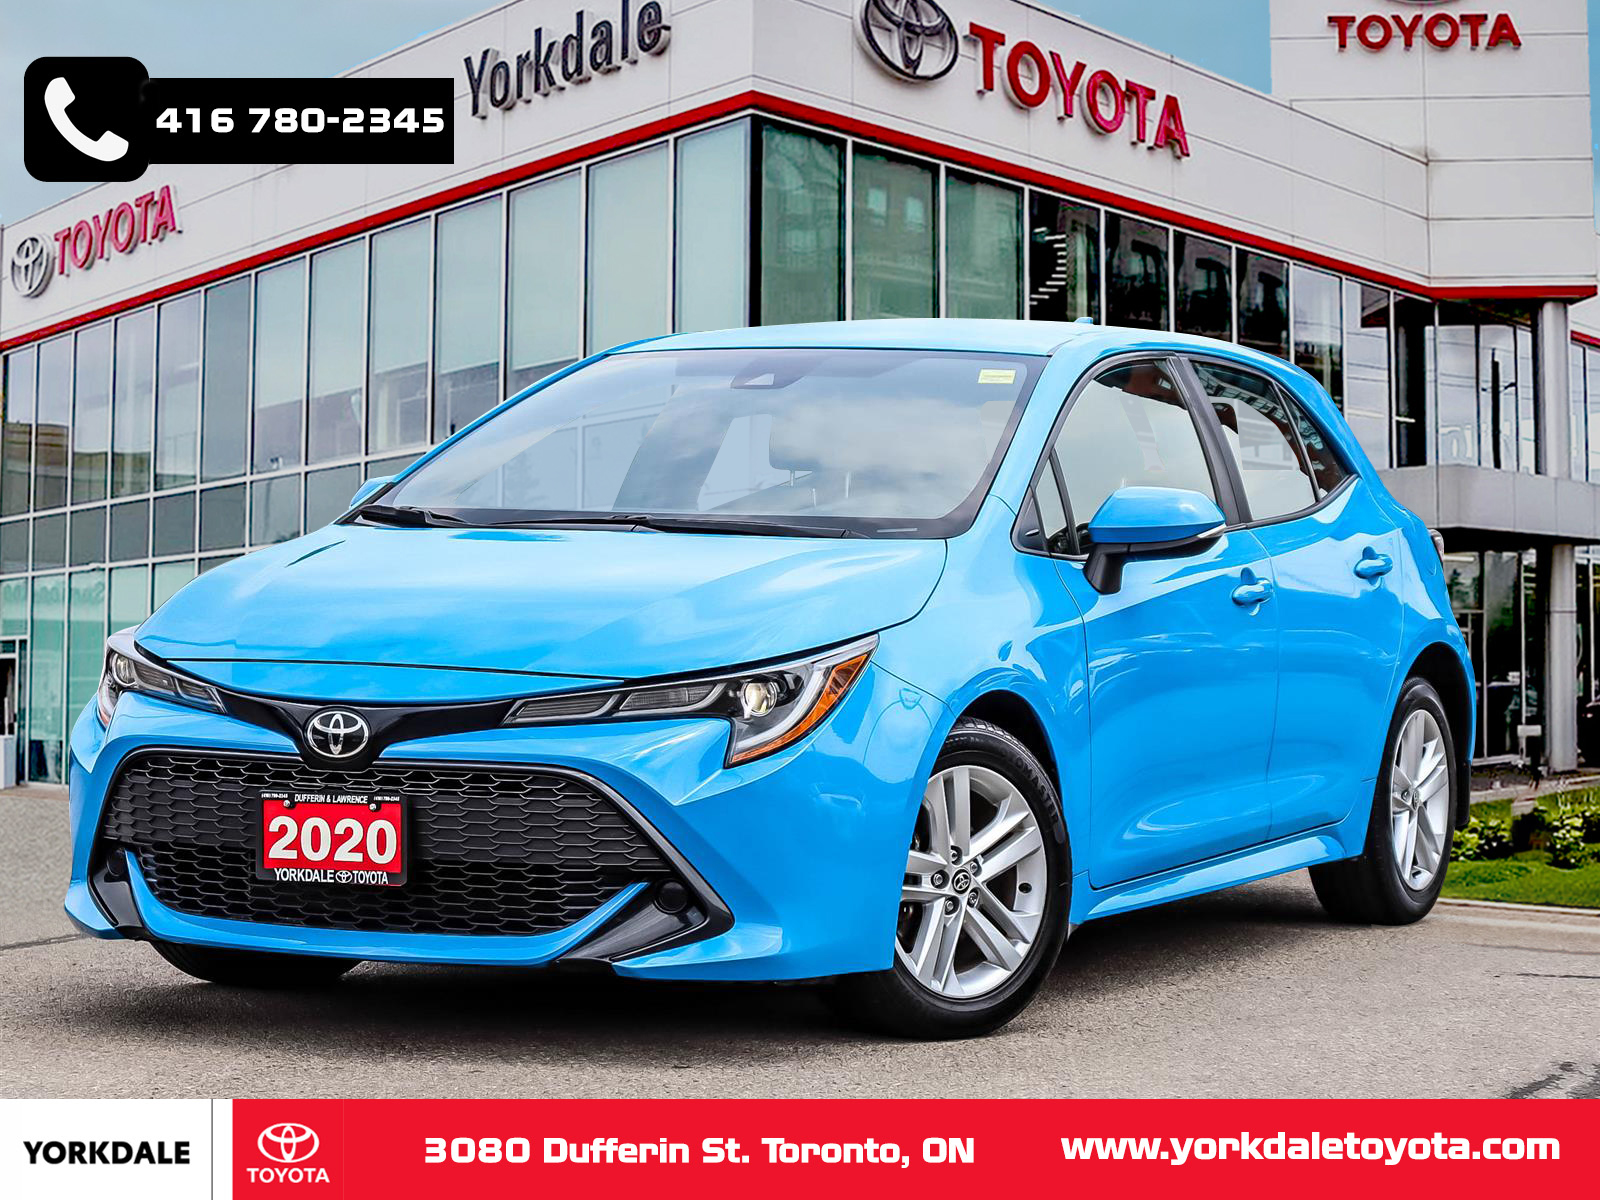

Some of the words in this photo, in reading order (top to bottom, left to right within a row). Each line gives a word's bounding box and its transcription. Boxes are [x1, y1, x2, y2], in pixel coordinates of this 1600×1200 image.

[1327, 13, 1522, 51] TOYOTA
[463, 0, 671, 119] Yorkdale
[963, 21, 1190, 160] TOYOTA
[53, 184, 183, 278] TOYOTA
[294, 793, 325, 803] DUFFERIN
[326, 795, 331, 803] &
[332, 795, 369, 804] LAWRENCE
[268, 815, 397, 864] 2020
[273, 867, 335, 883] YORKDALE
[352, 870, 389, 884] TOYOTA
